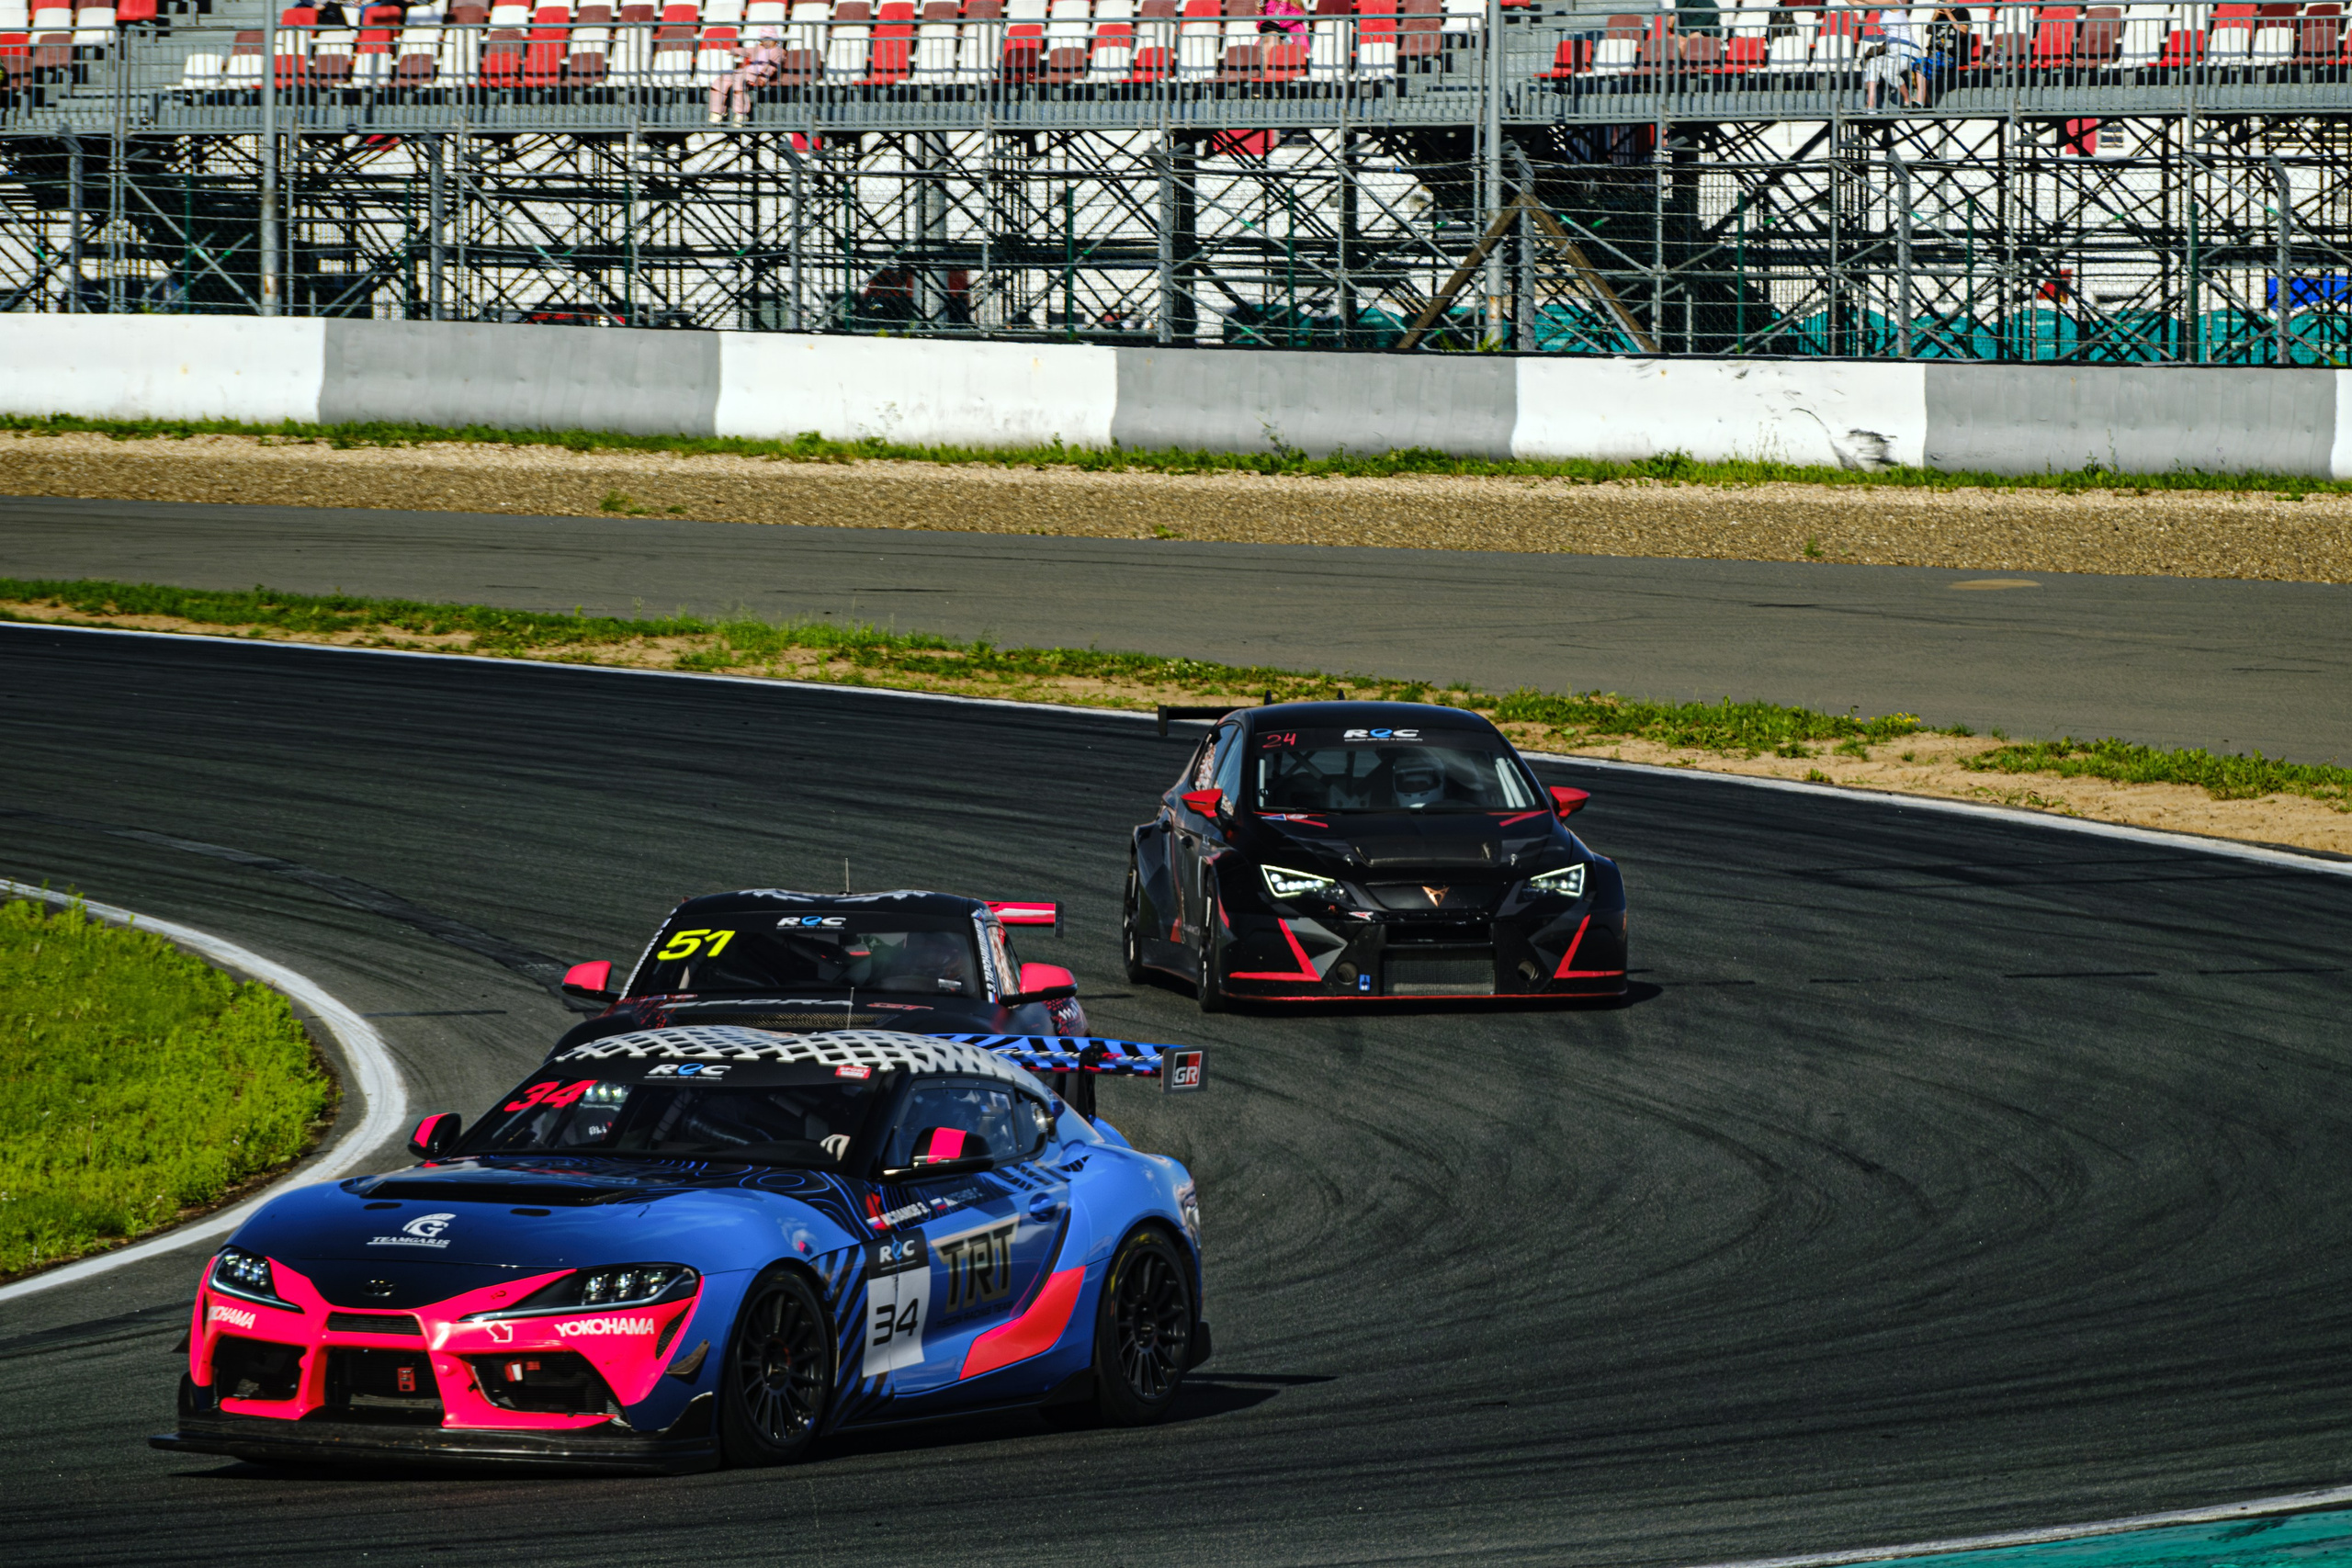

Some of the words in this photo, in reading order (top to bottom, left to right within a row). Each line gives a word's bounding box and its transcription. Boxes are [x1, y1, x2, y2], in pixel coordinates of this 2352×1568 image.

[1261, 732, 1296, 749] 24
[657, 929, 736, 961] 51
[1174, 1066, 1198, 1083] GR
[503, 1079, 599, 1111] 34
[372, 1236, 451, 1247] TEAMGARIS
[933, 1216, 1018, 1311] TRT
[554, 1317, 655, 1337] YOKOHAMA
[873, 1297, 919, 1347] 34
